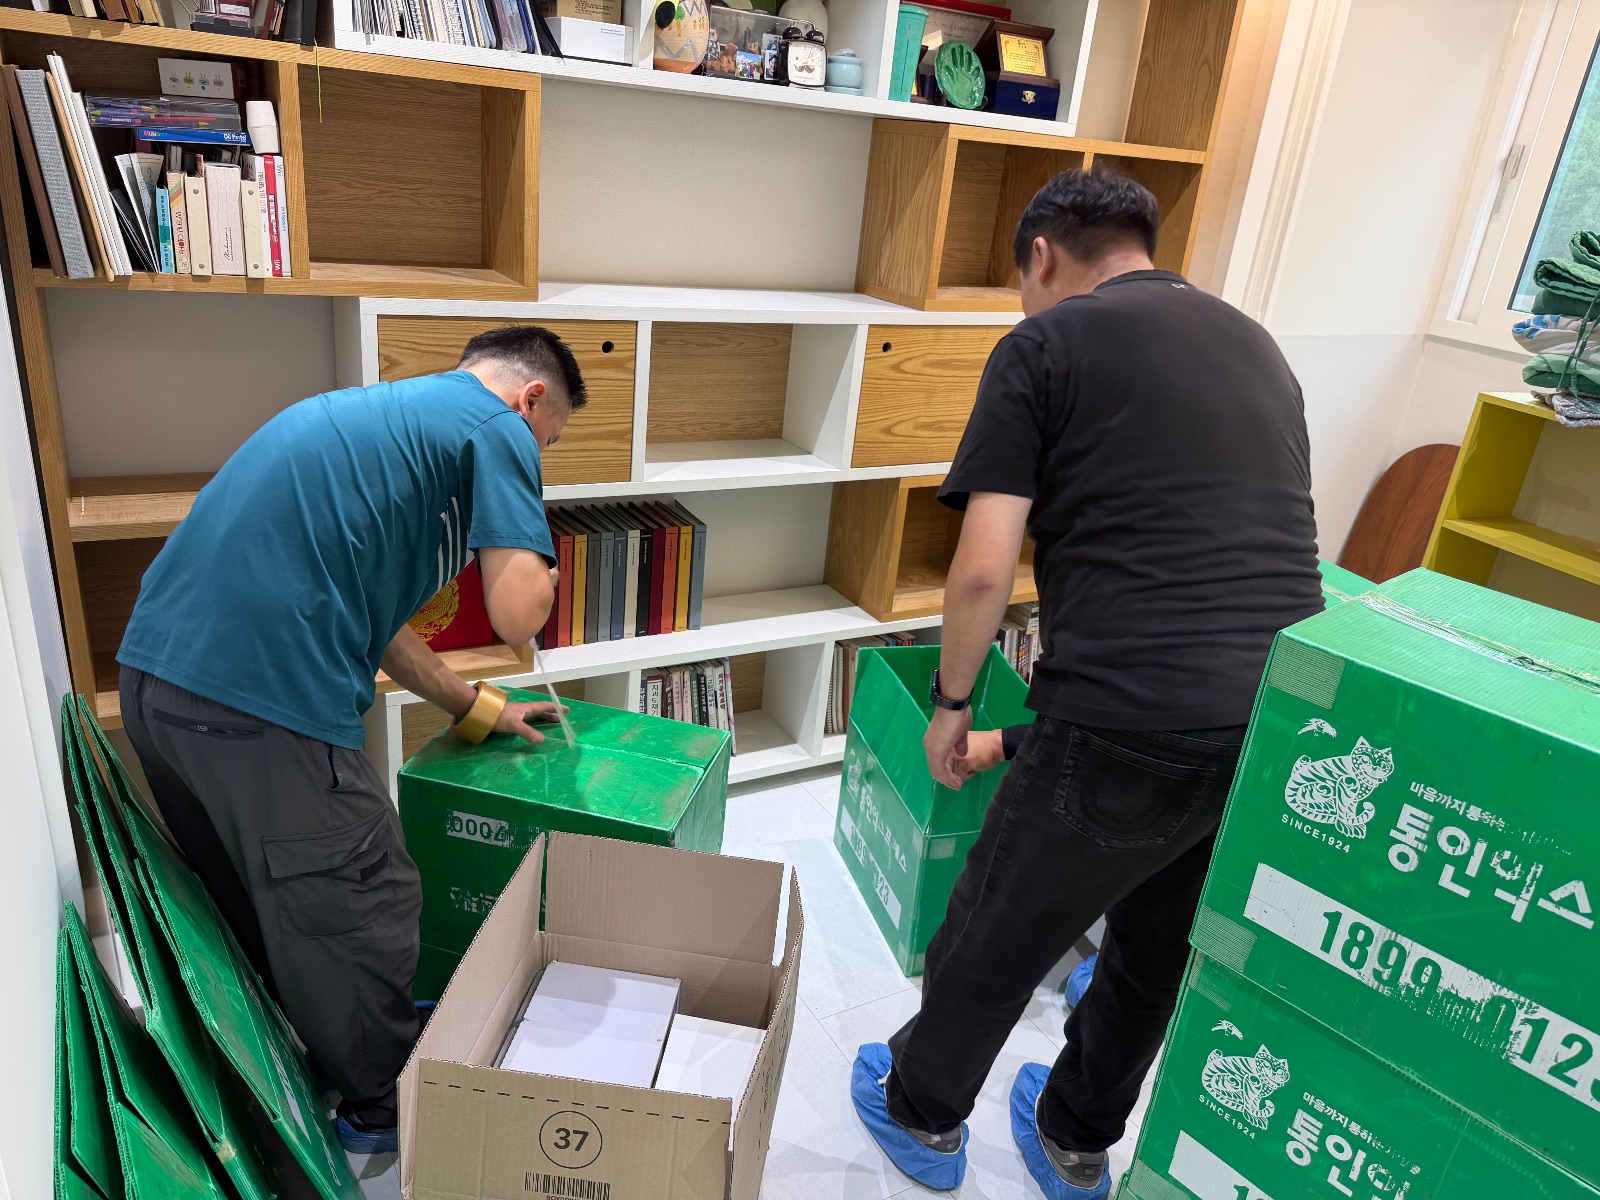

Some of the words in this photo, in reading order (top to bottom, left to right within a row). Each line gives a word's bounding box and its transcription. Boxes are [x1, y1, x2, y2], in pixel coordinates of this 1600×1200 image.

[273, 259, 281, 271] Wii
[1409, 780, 1467, 815] 마음까지
[1303, 1091, 1349, 1128] 마음까지
[553, 1127, 590, 1152] 37
